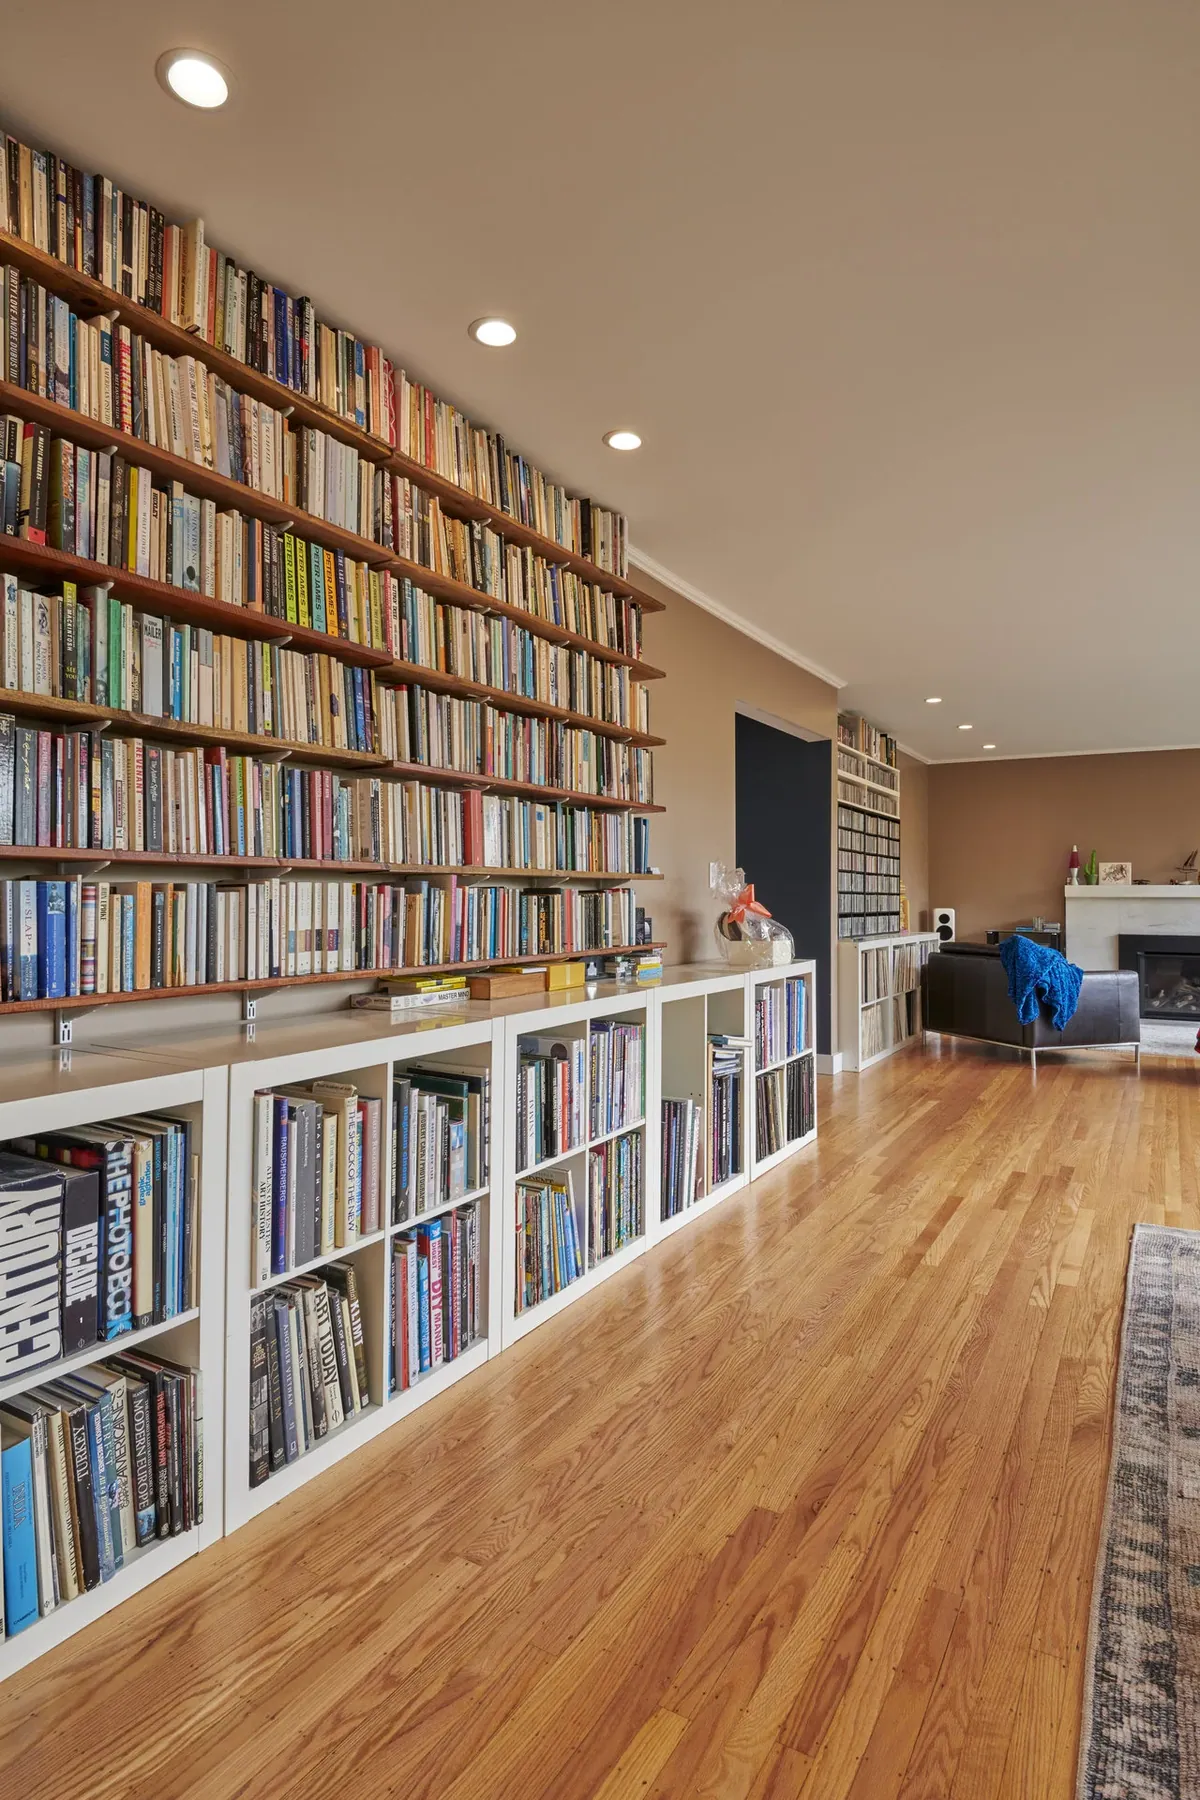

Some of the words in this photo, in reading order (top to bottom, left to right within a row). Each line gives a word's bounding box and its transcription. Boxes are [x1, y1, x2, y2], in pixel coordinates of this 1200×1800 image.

[9, 270, 18, 294] DIRTY
[10, 296, 18, 315] LOVE
[10, 316, 18, 341] ANDRE
[313, 546, 321, 577] PETER
[325, 553, 333, 583] PETER
[327, 584, 335, 616] JAMES
[144, 623, 161, 640] MAILER
[24, 909, 32, 940] SLAP
[438, 992, 457, 1001] MASTER
[458, 990, 470, 999] MIND
[348, 1111, 356, 1130] THE
[279, 1136, 287, 1201] RAUSCHENBERG
[348, 1131, 356, 1168] SHOCK
[107, 1148, 132, 1193] THE
[348, 1171, 356, 1182] OF
[138, 1176, 146, 1206] graphic
[0, 1186, 61, 1375] CENTURY
[66, 1222, 97, 1307] DECADE
[315, 1291, 330, 1330] ART
[431, 1278, 442, 1311] DIY
[338, 1329, 344, 1339] OF
[350, 1300, 363, 1348] KLIMT
[434, 1313, 442, 1361] MANUAL
[283, 1324, 291, 1365] ANOTHER
[319, 1330, 338, 1388] TODAY
[270, 1338, 281, 1420] REQUIEM
[285, 1367, 293, 1407] VIETNAM
[156, 1392, 164, 1410] THE
[101, 1404, 113, 1466] EVEREST
[132, 1398, 146, 1457] MODERN
[157, 1410, 166, 1450] IMPERIAL
[73, 1425, 89, 1482] TURKEY
[100, 1486, 106, 1494] 14
[136, 1458, 149, 1510] EUROPE
[12, 1482, 26, 1529] INDIA
